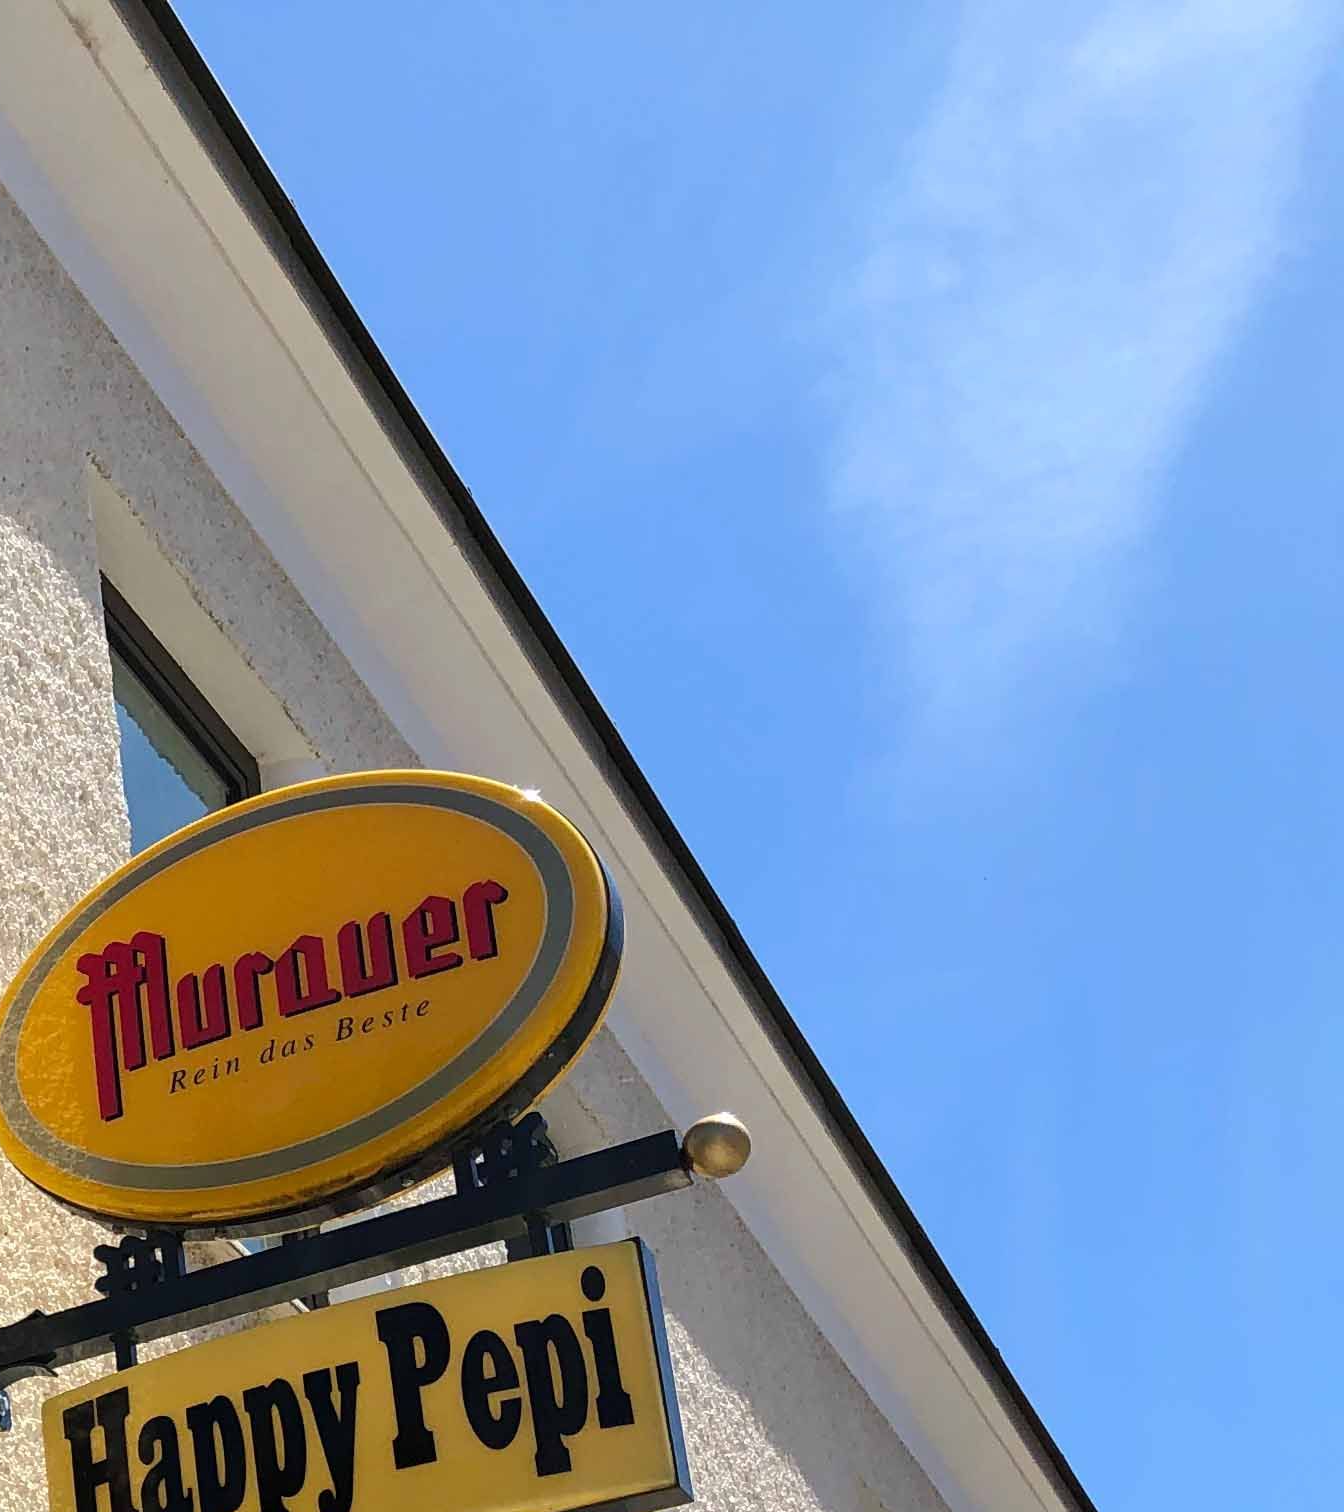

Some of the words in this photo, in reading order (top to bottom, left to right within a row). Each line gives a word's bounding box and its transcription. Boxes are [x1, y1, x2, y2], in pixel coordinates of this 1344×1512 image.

[76, 878, 509, 1120] Murauer
[169, 1055, 241, 1094] Rein
[259, 1032, 315, 1064] das
[335, 999, 432, 1042] Beste
[376, 1265, 635, 1477] Pepi
